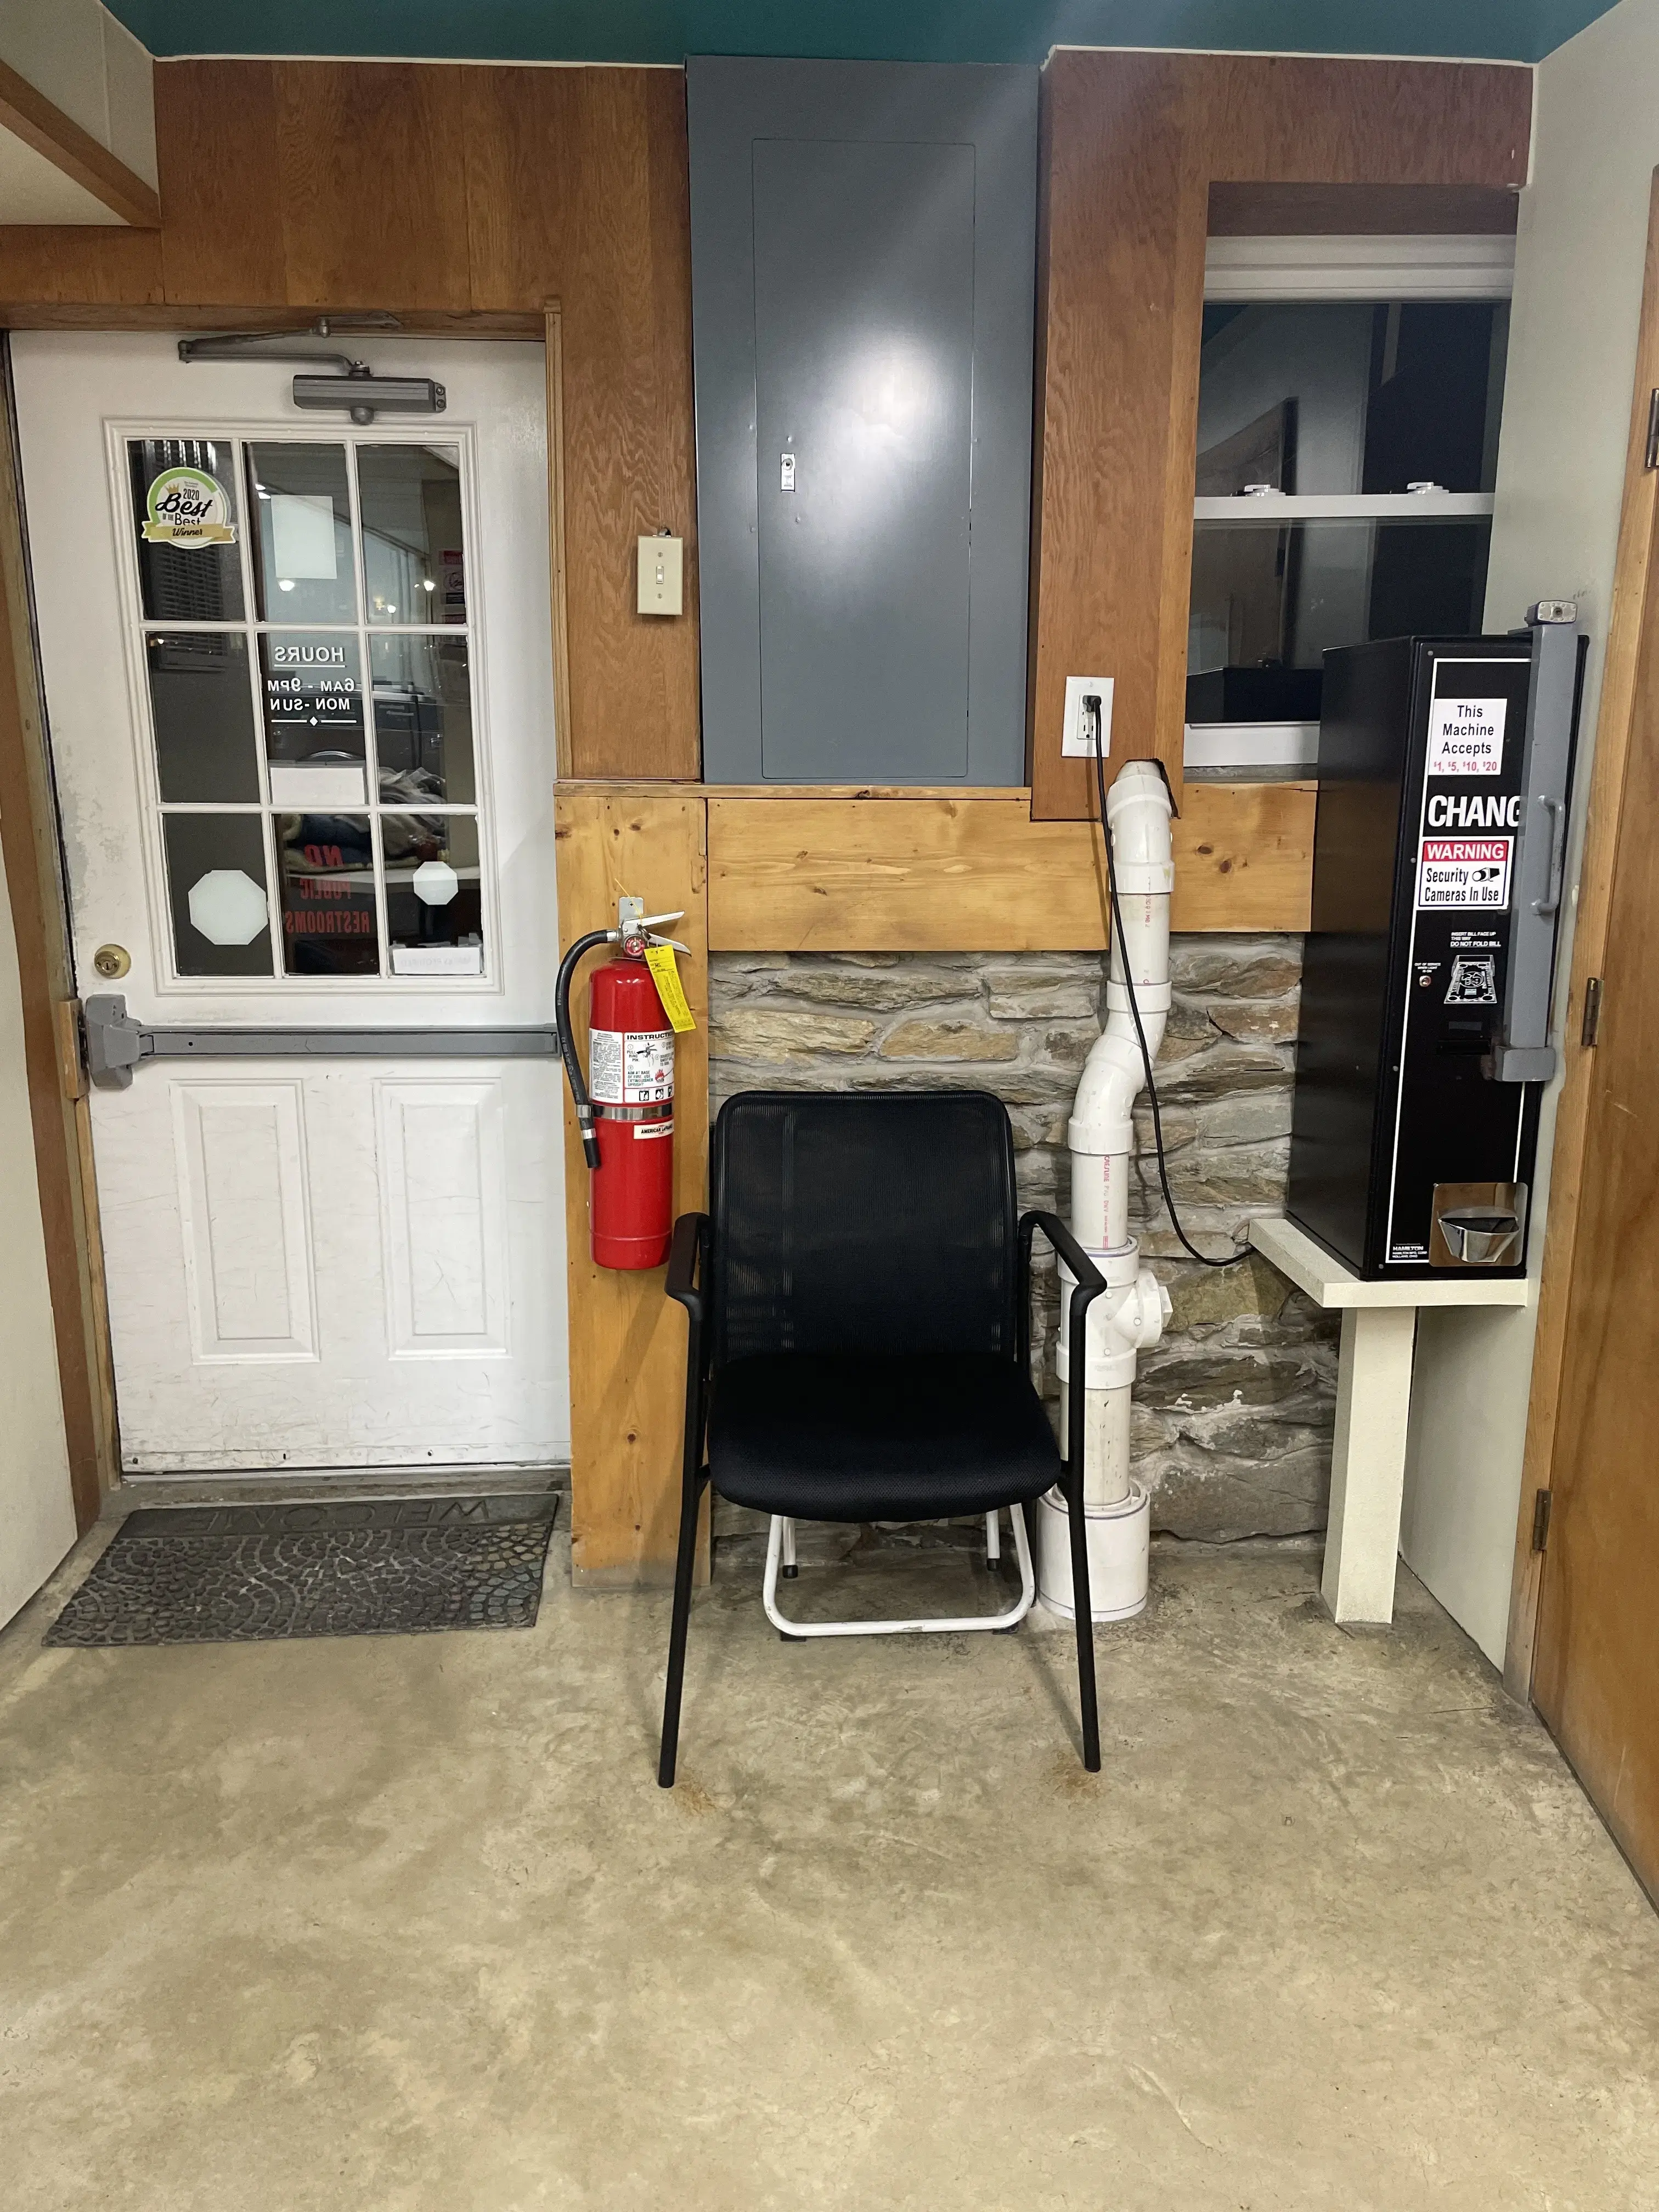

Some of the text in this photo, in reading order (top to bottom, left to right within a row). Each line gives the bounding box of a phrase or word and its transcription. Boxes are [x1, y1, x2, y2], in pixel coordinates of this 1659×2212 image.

[183, 488, 200, 500] 2020
[155, 492, 213, 517] Best
[175, 513, 201, 525] Best
[172, 527, 203, 537] Winner
[1457, 705, 1483, 718] This
[1442, 723, 1494, 736] Machine
[1441, 742, 1492, 755] Accepts
[1483, 761, 1497, 772] $20
[1426, 844, 1505, 860] WARNING
[1426, 868, 1469, 883] Security
[1425, 887, 1499, 902] Cameras In Use
[185, 1499, 490, 1532] WELCOME
